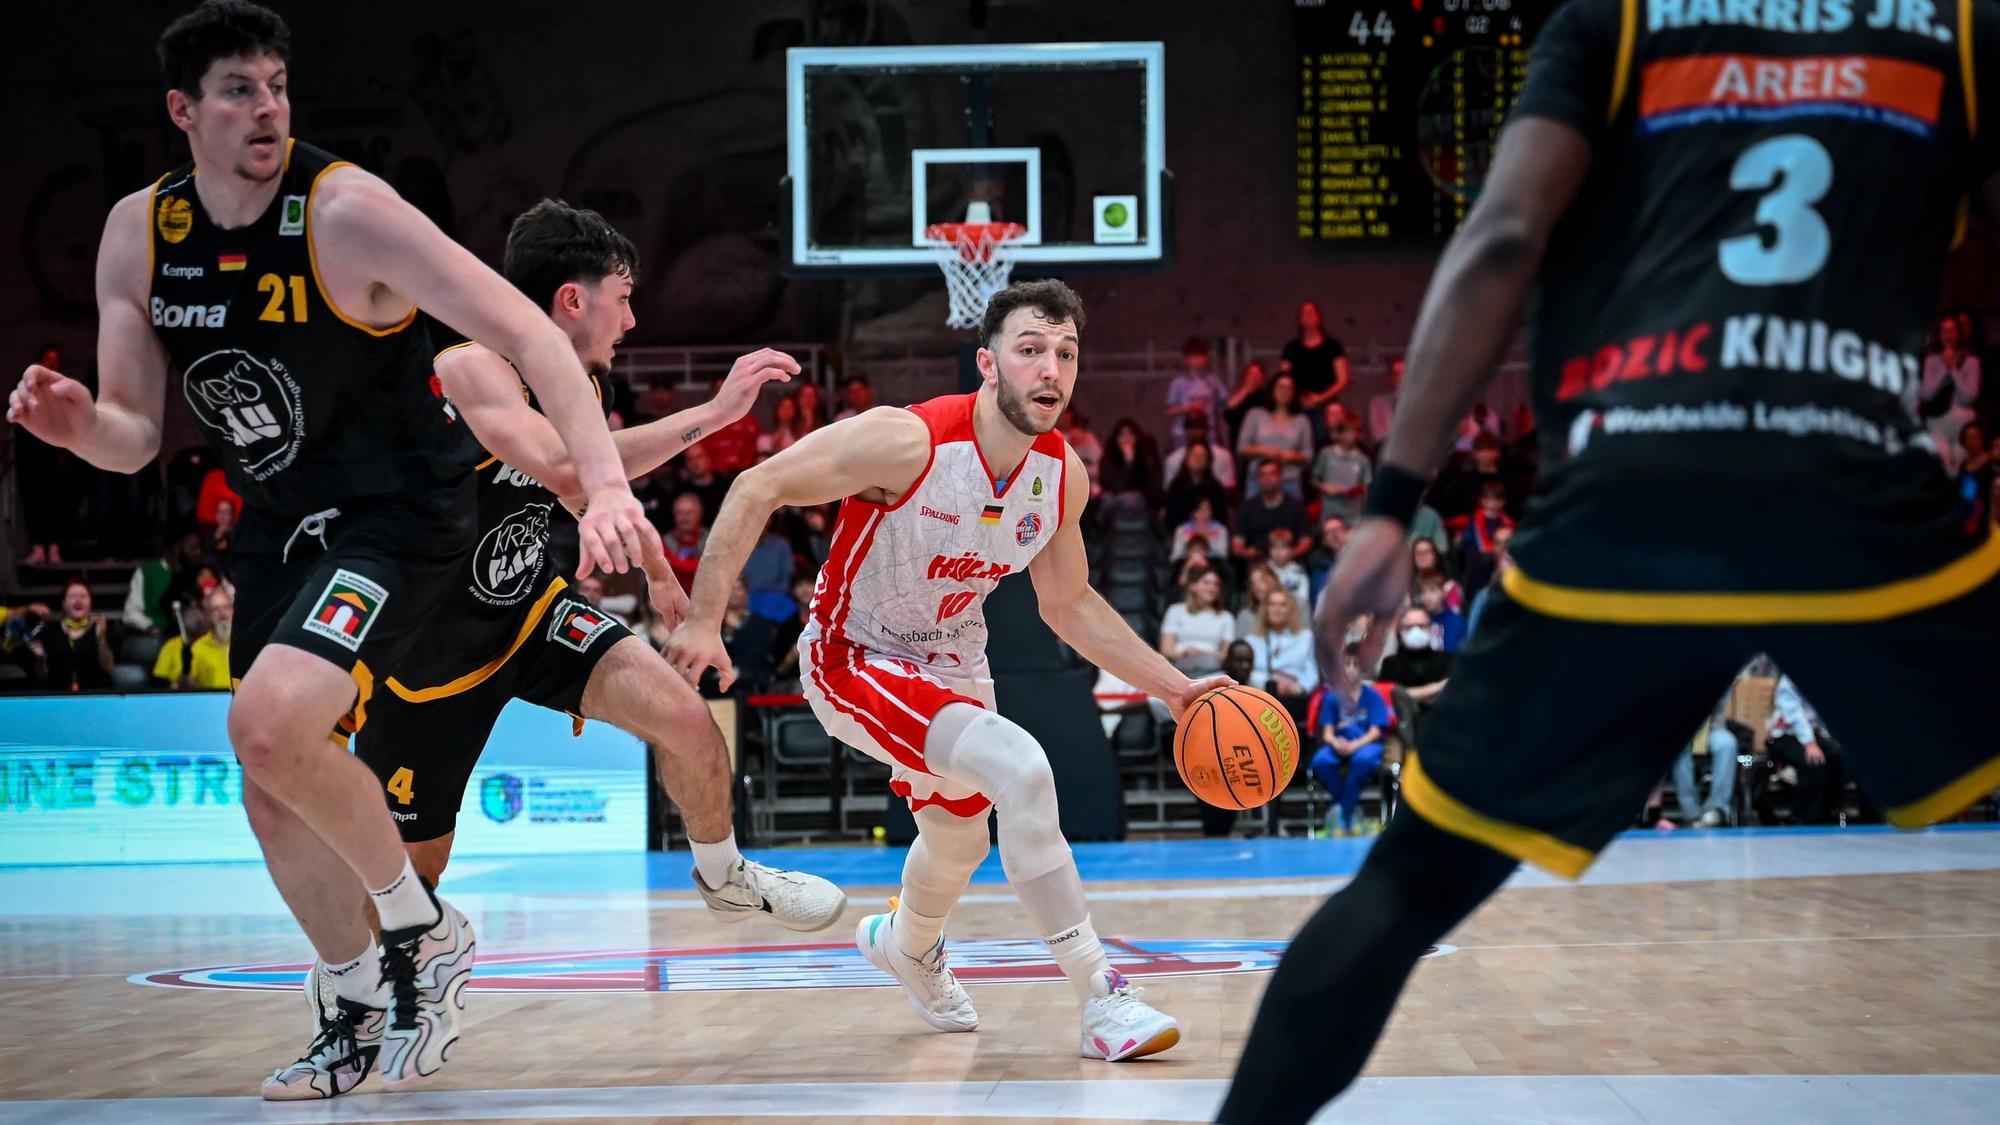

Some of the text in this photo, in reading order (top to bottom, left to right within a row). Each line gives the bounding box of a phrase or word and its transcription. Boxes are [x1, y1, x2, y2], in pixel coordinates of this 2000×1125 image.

[1348, 10, 1395, 45] 44
[1647, 0, 1953, 42] HARRIS JR.
[1713, 60, 1868, 100] AREIS
[1718, 134, 1834, 286] 3
[162, 263, 204, 279] Kempa
[150, 297, 228, 329] Bona
[257, 272, 308, 323] 21
[681, 427, 701, 443] 1977
[920, 506, 960, 525] SPALDING
[936, 591, 977, 624] 10
[1260, 706, 1292, 785] Wilson
[113, 755, 242, 806] STR
[1223, 757, 1240, 785] GAME
[1233, 745, 1260, 787] EVO
[387, 766, 414, 805] 4
[391, 811, 417, 822] mpa
